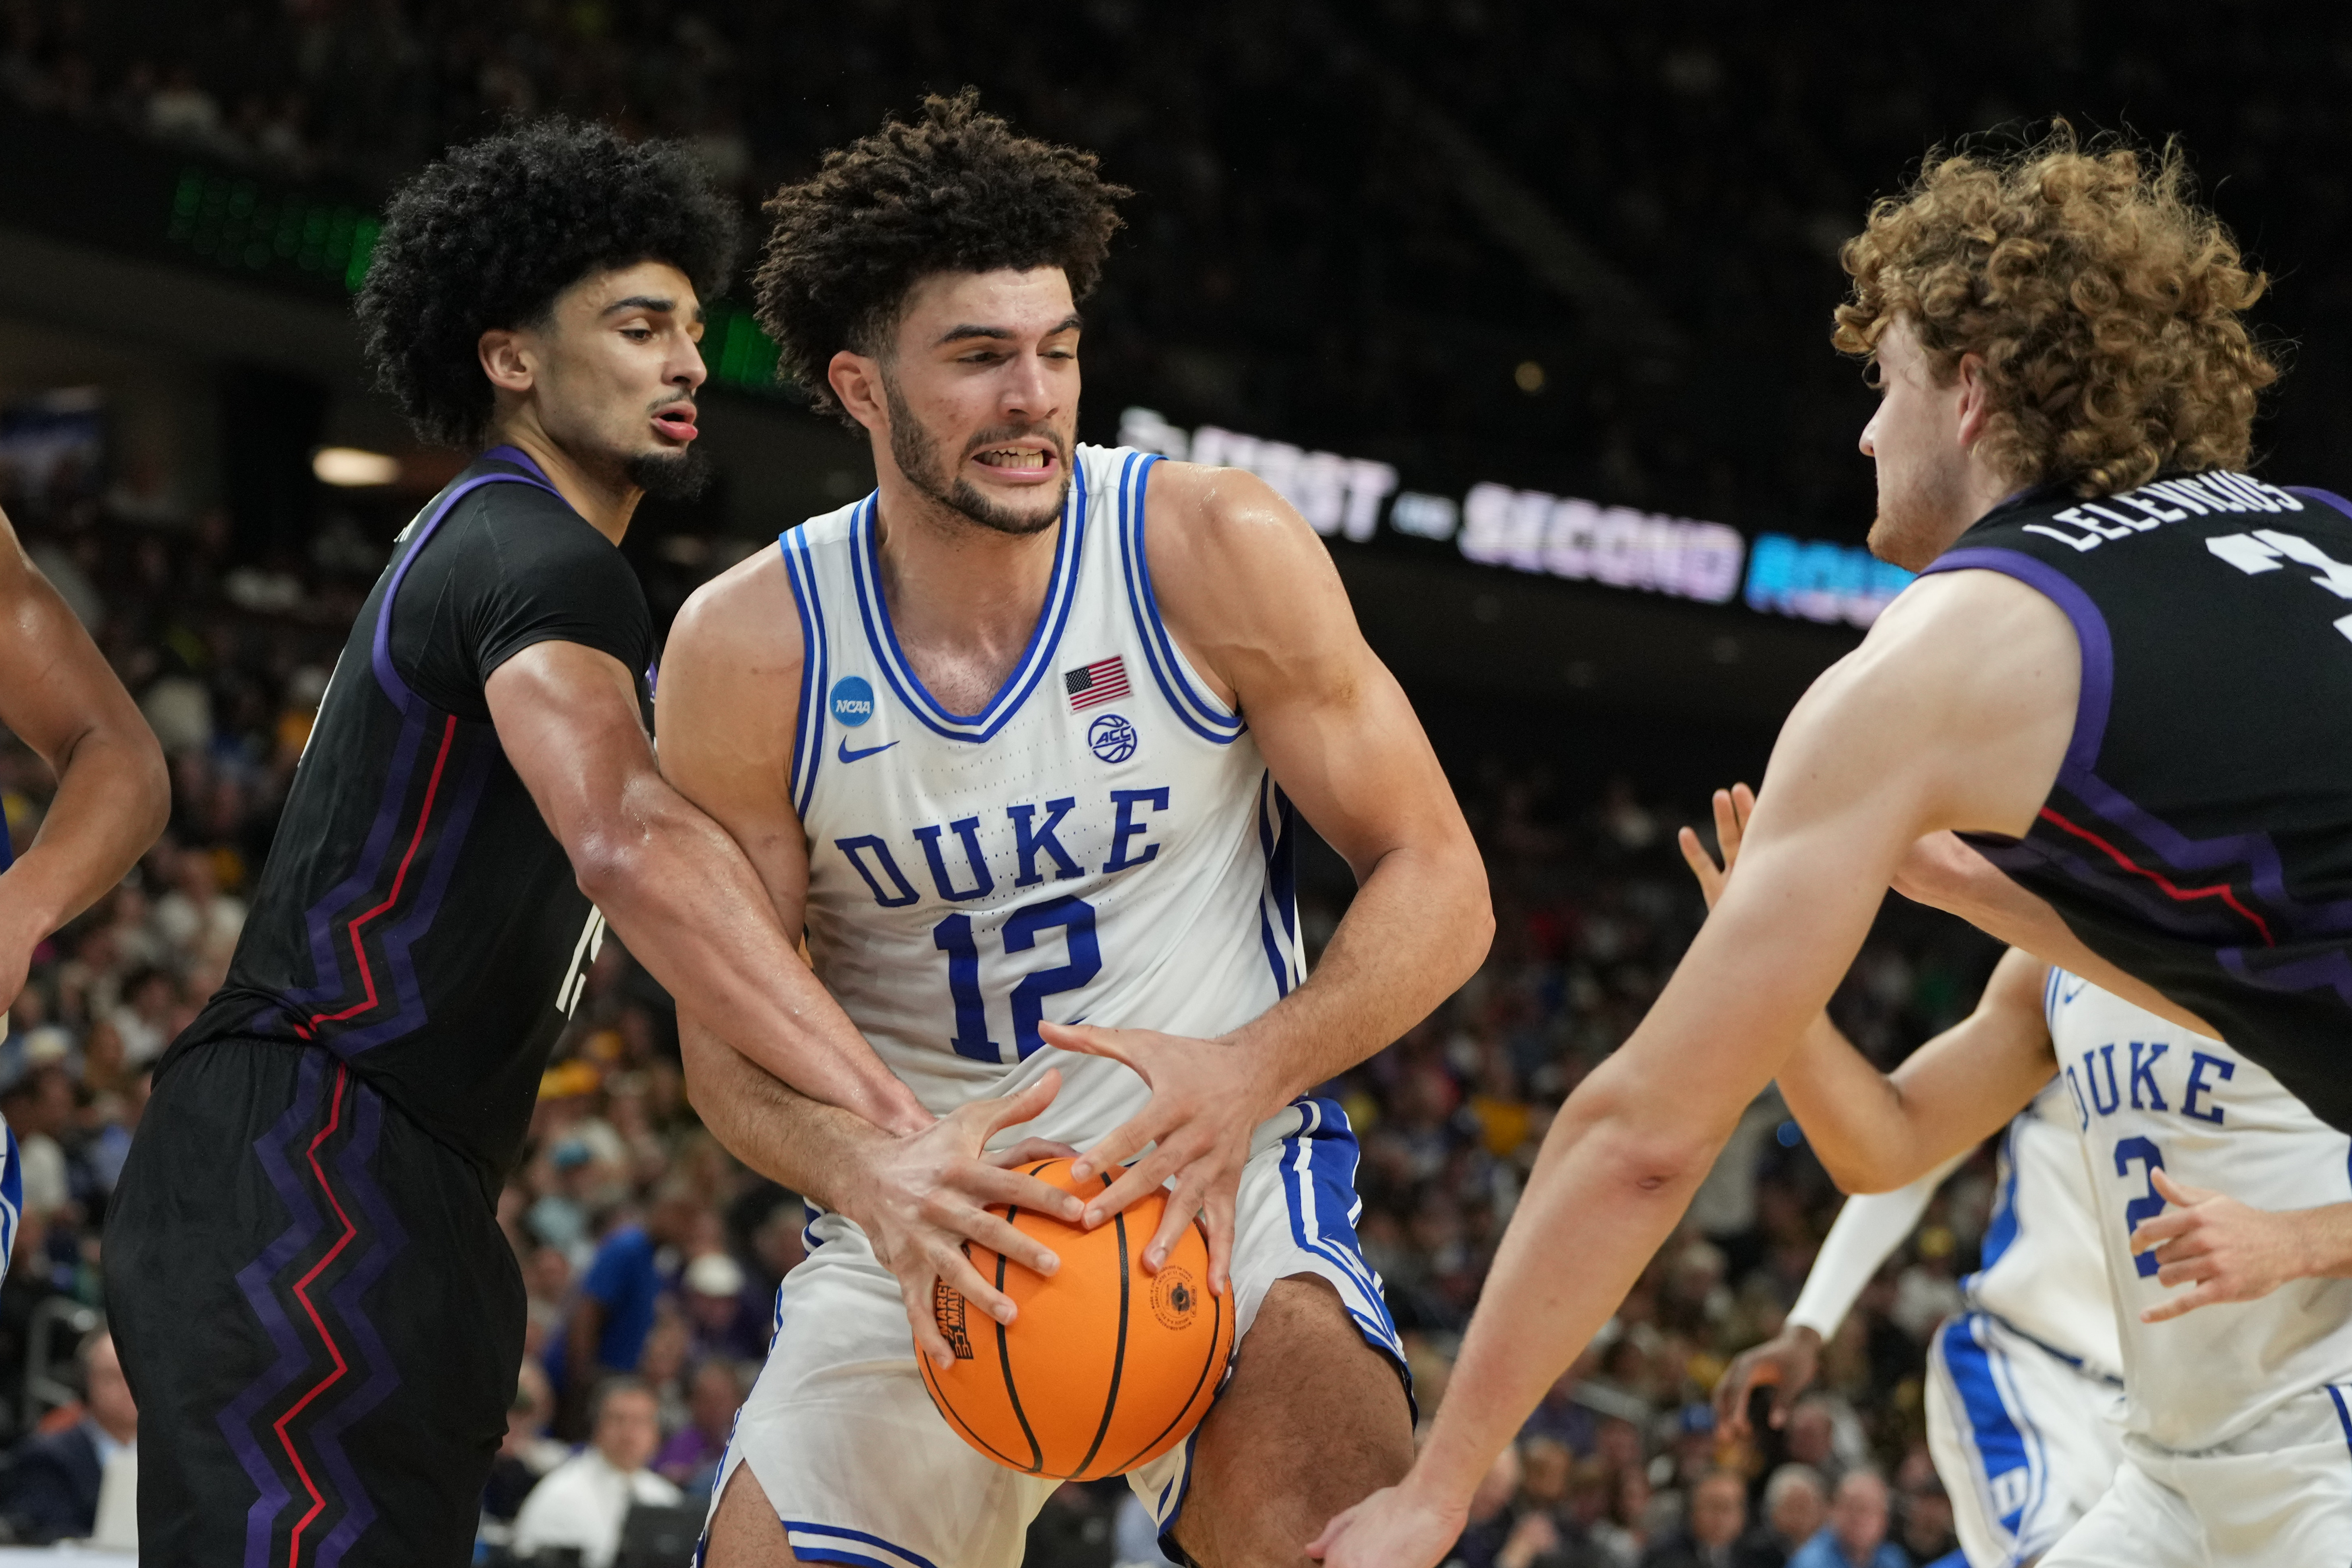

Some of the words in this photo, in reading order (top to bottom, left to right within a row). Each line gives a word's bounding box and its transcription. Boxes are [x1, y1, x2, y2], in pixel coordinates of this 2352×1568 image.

[835, 700, 871, 714] NCAA
[1096, 725, 1131, 745] ACC
[834, 786, 1169, 907] DUKE
[933, 895, 1102, 1064] 12
[2114, 1136, 2167, 1278] 2
